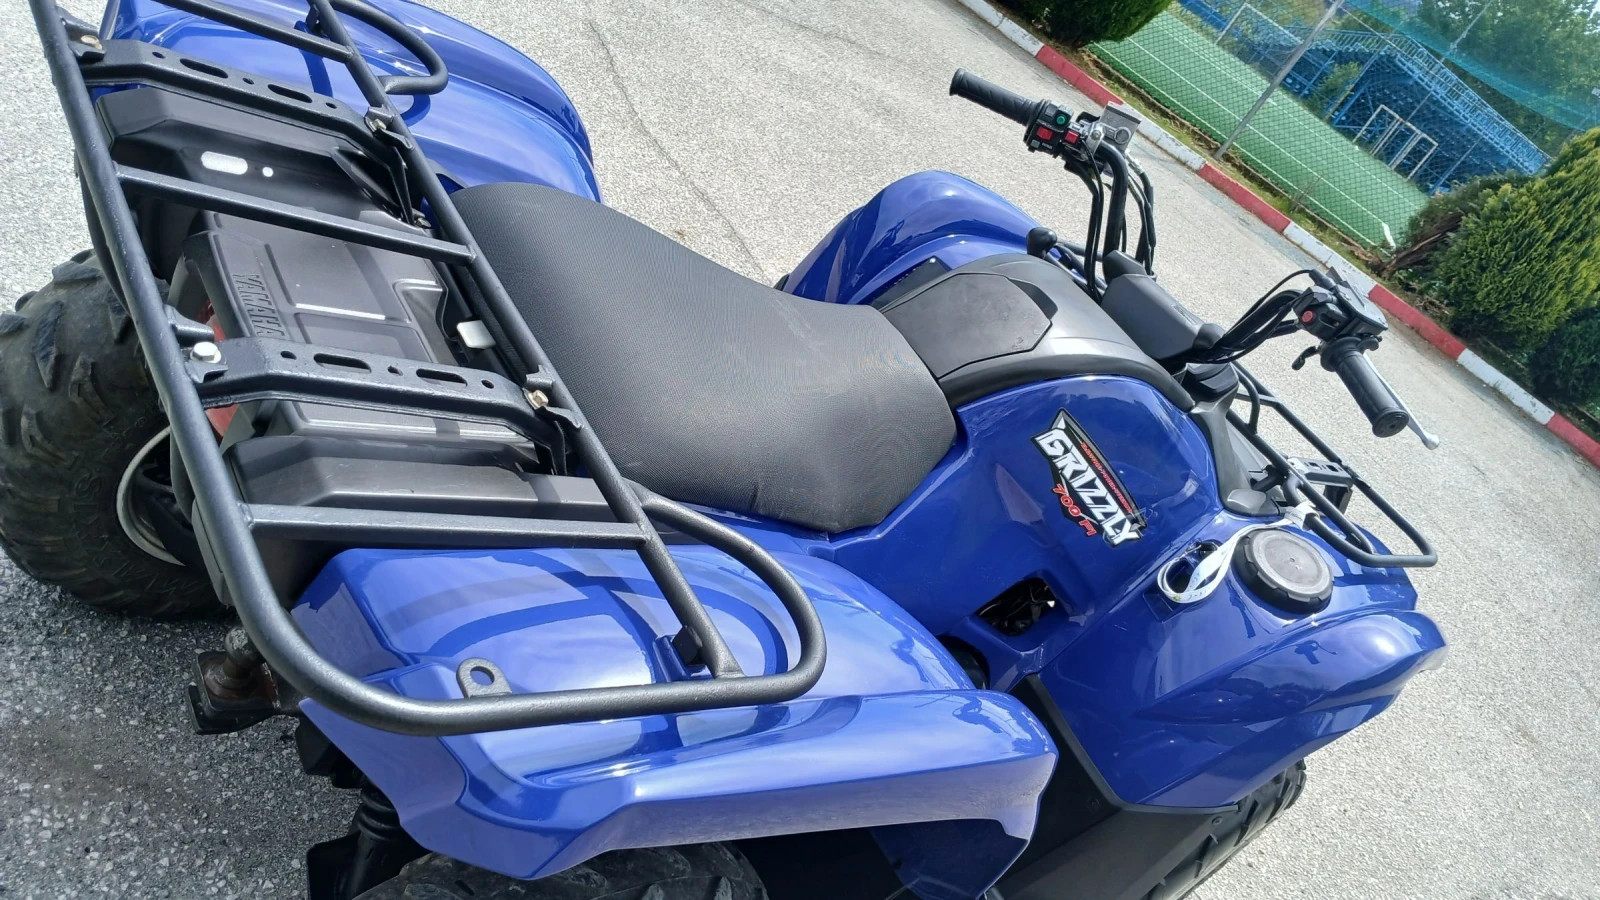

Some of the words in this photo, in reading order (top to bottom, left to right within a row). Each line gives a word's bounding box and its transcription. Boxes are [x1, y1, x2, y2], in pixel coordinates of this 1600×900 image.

[232, 274, 286, 337] YAMAHA
[1034, 427, 1141, 546] GRIZZLY
[1052, 483, 1082, 517] 700
